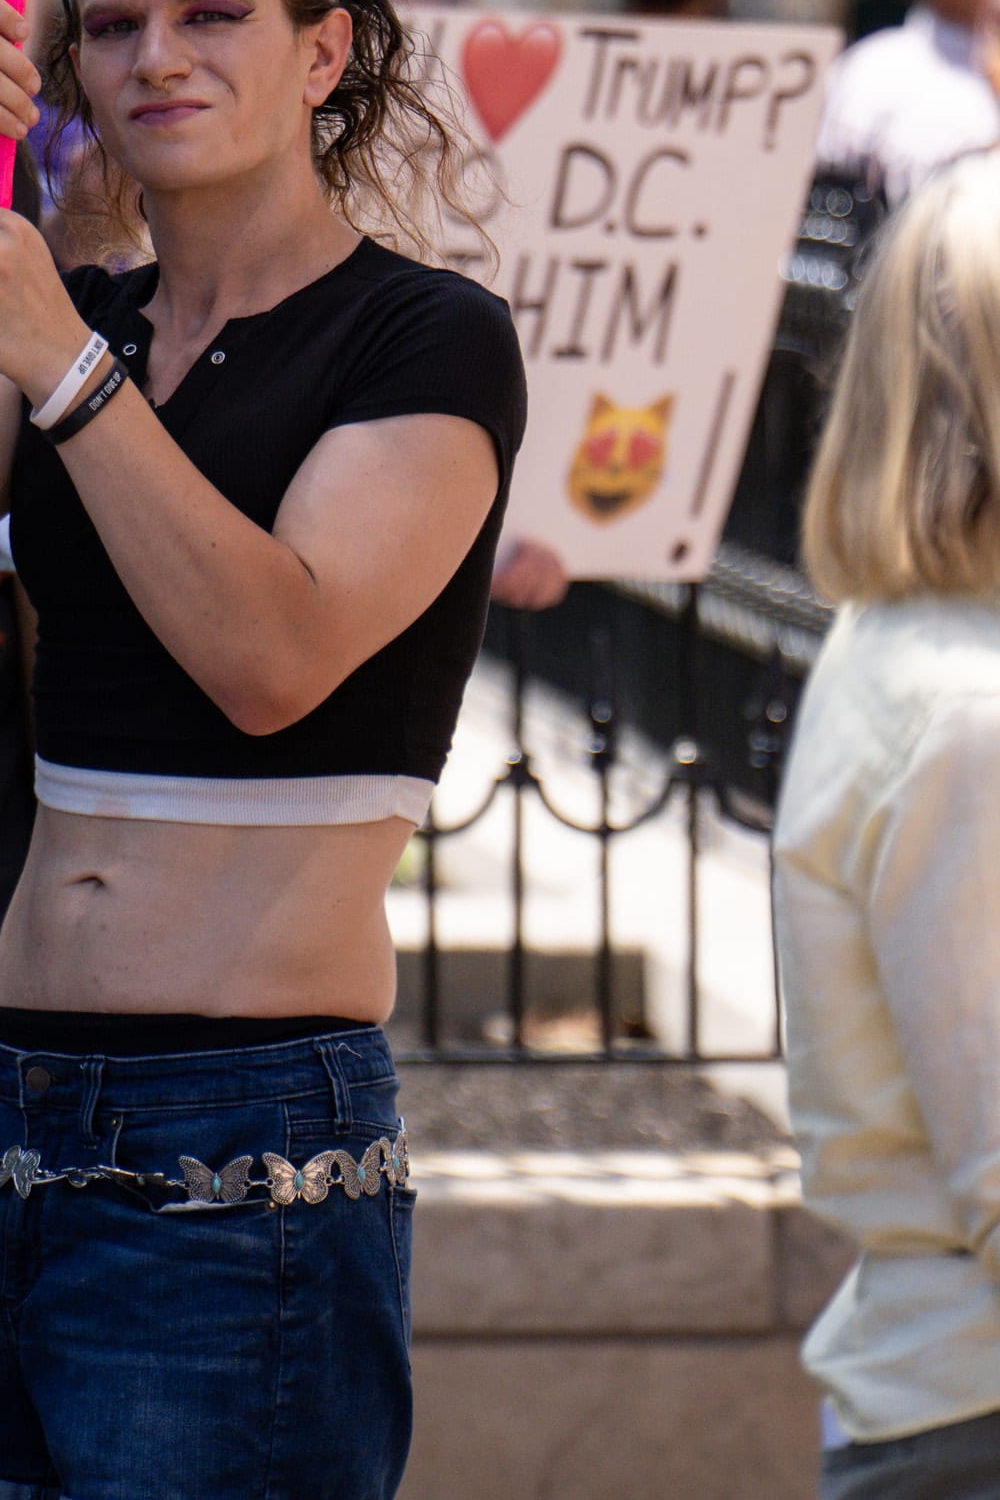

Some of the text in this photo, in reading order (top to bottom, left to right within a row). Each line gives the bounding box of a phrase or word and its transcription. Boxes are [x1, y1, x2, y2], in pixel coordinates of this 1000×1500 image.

[552, 144, 708, 240] D.C.
[512, 256, 679, 366] HIM
[89, 391, 108, 412] DON'T
